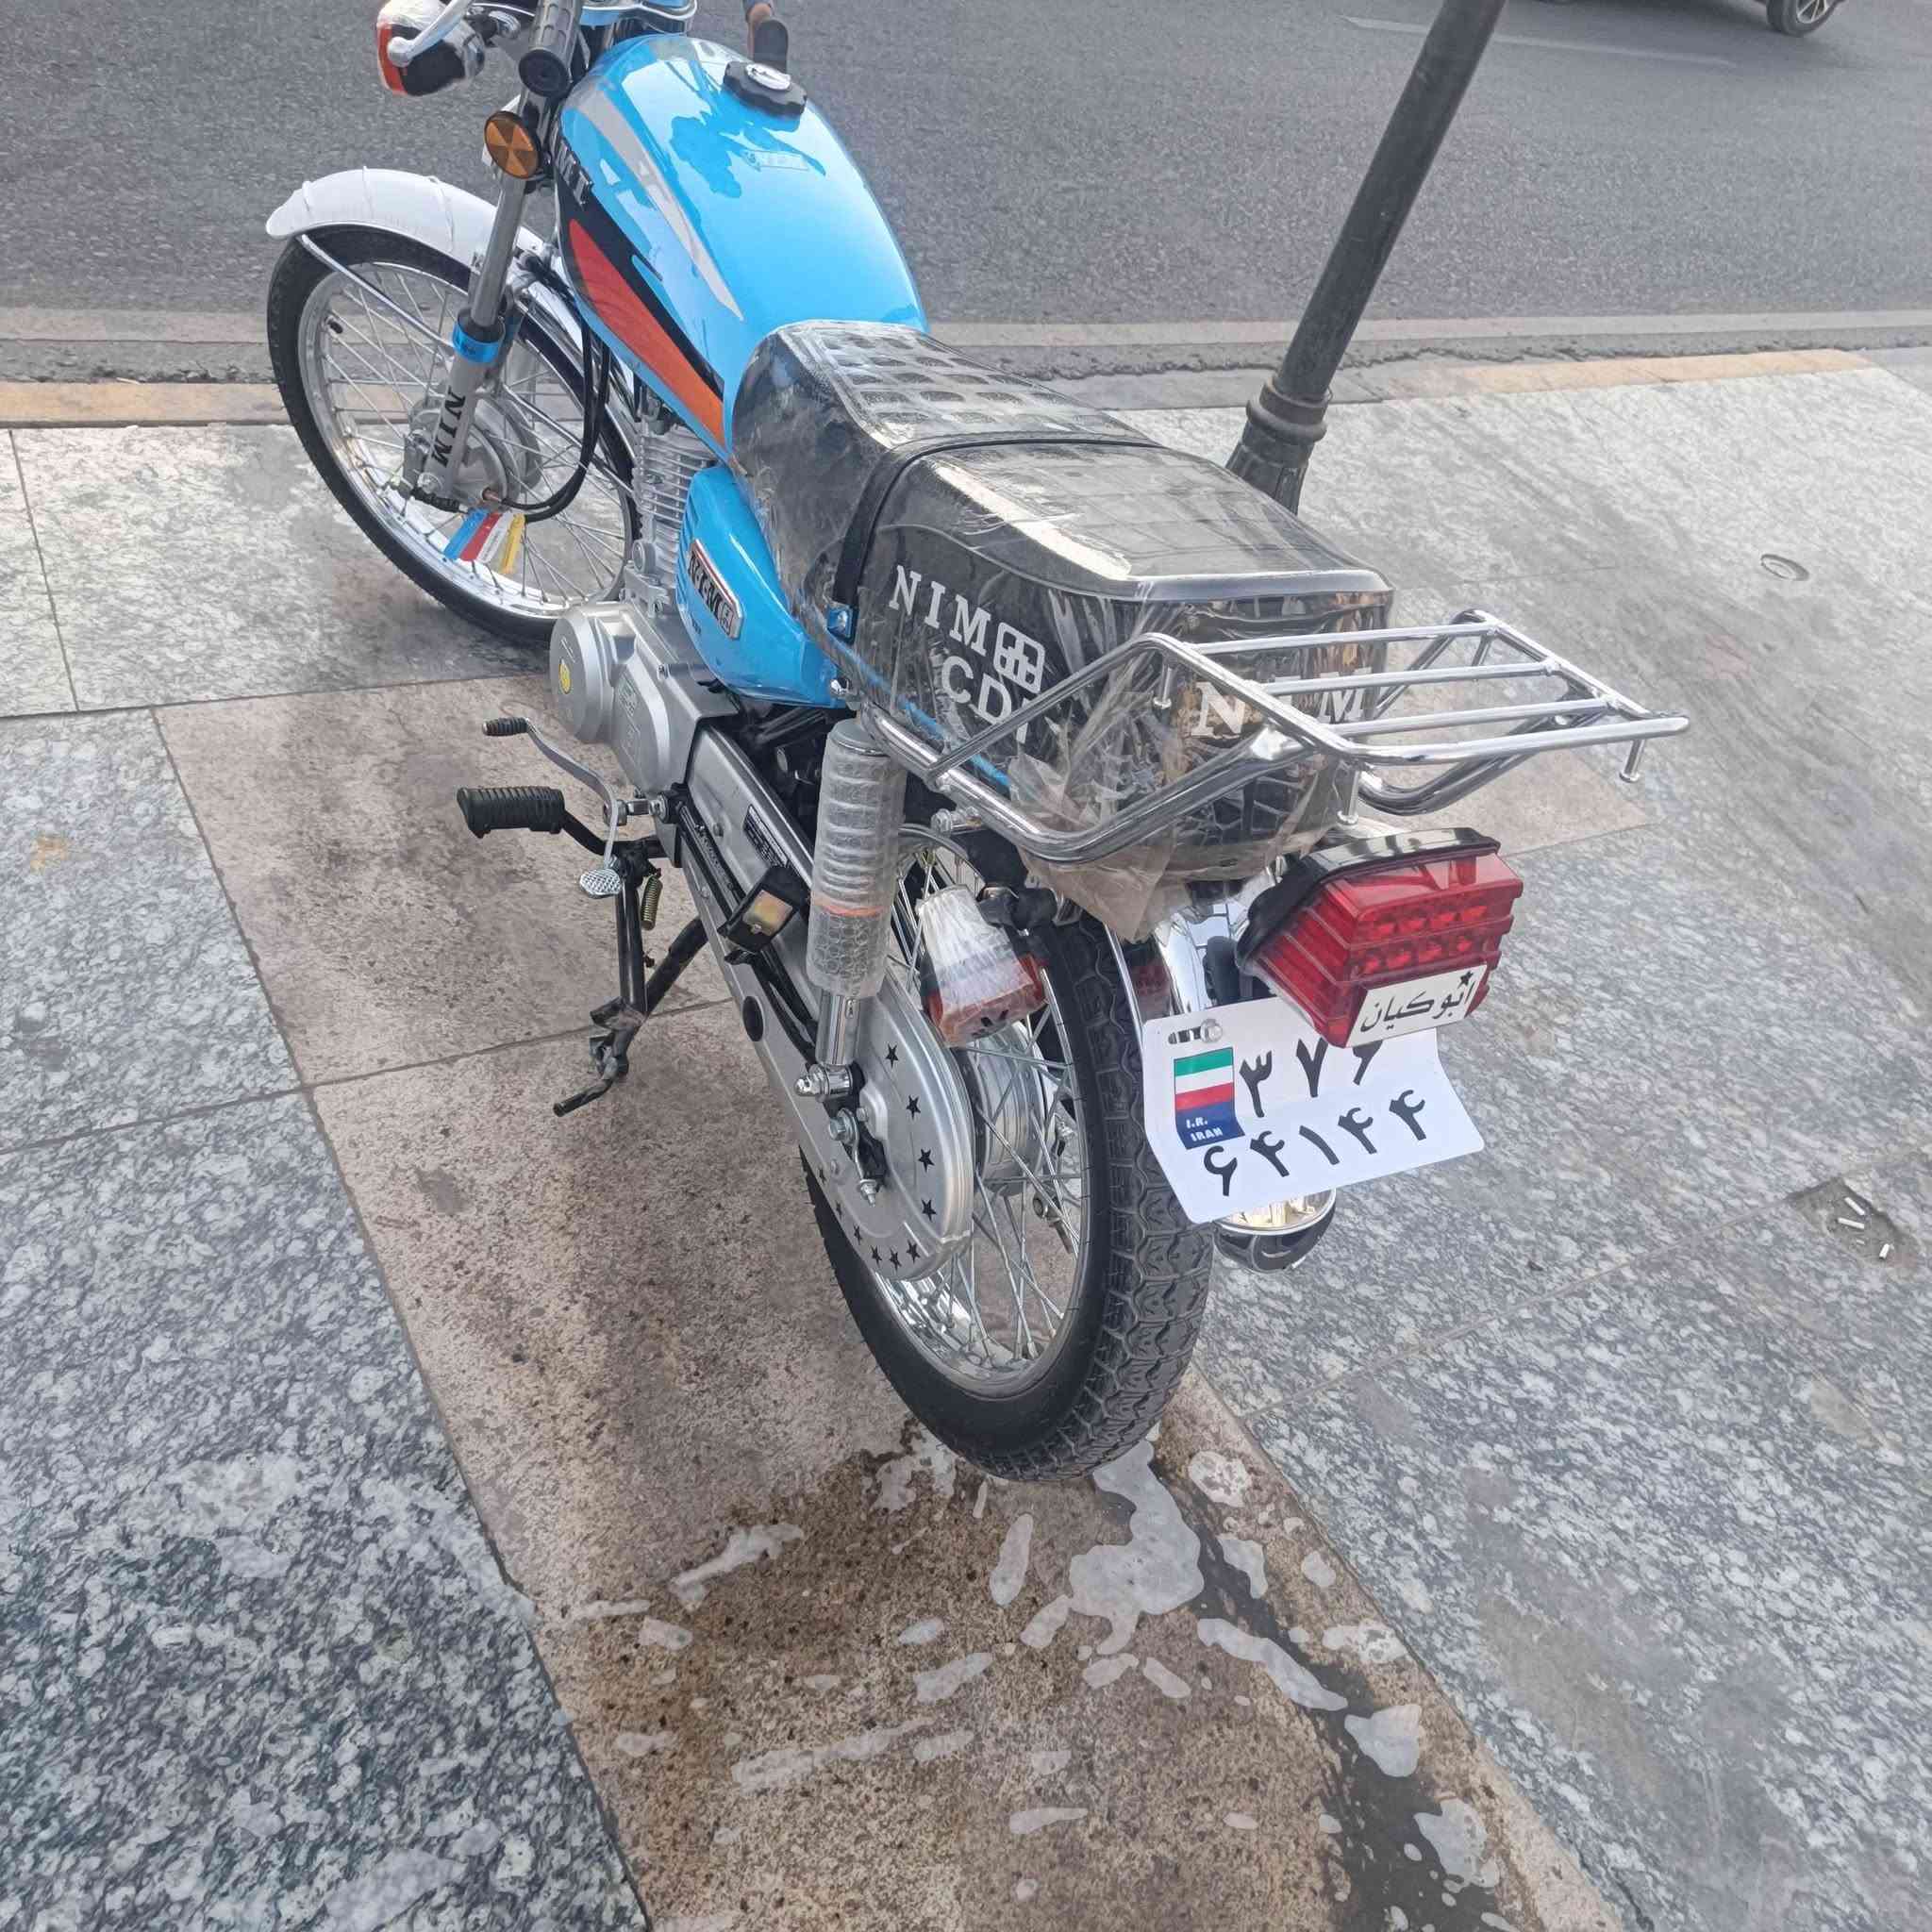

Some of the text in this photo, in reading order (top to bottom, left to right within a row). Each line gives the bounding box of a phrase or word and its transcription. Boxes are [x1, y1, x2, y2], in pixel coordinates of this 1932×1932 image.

[431, 386, 466, 468] NIM
[889, 565, 991, 657] NIM
[1186, 1116, 1208, 1130] I.R.
[1190, 1126, 1224, 1142] IRAN
[1204, 1089, 1427, 1197] ۶۴۱۴۴
